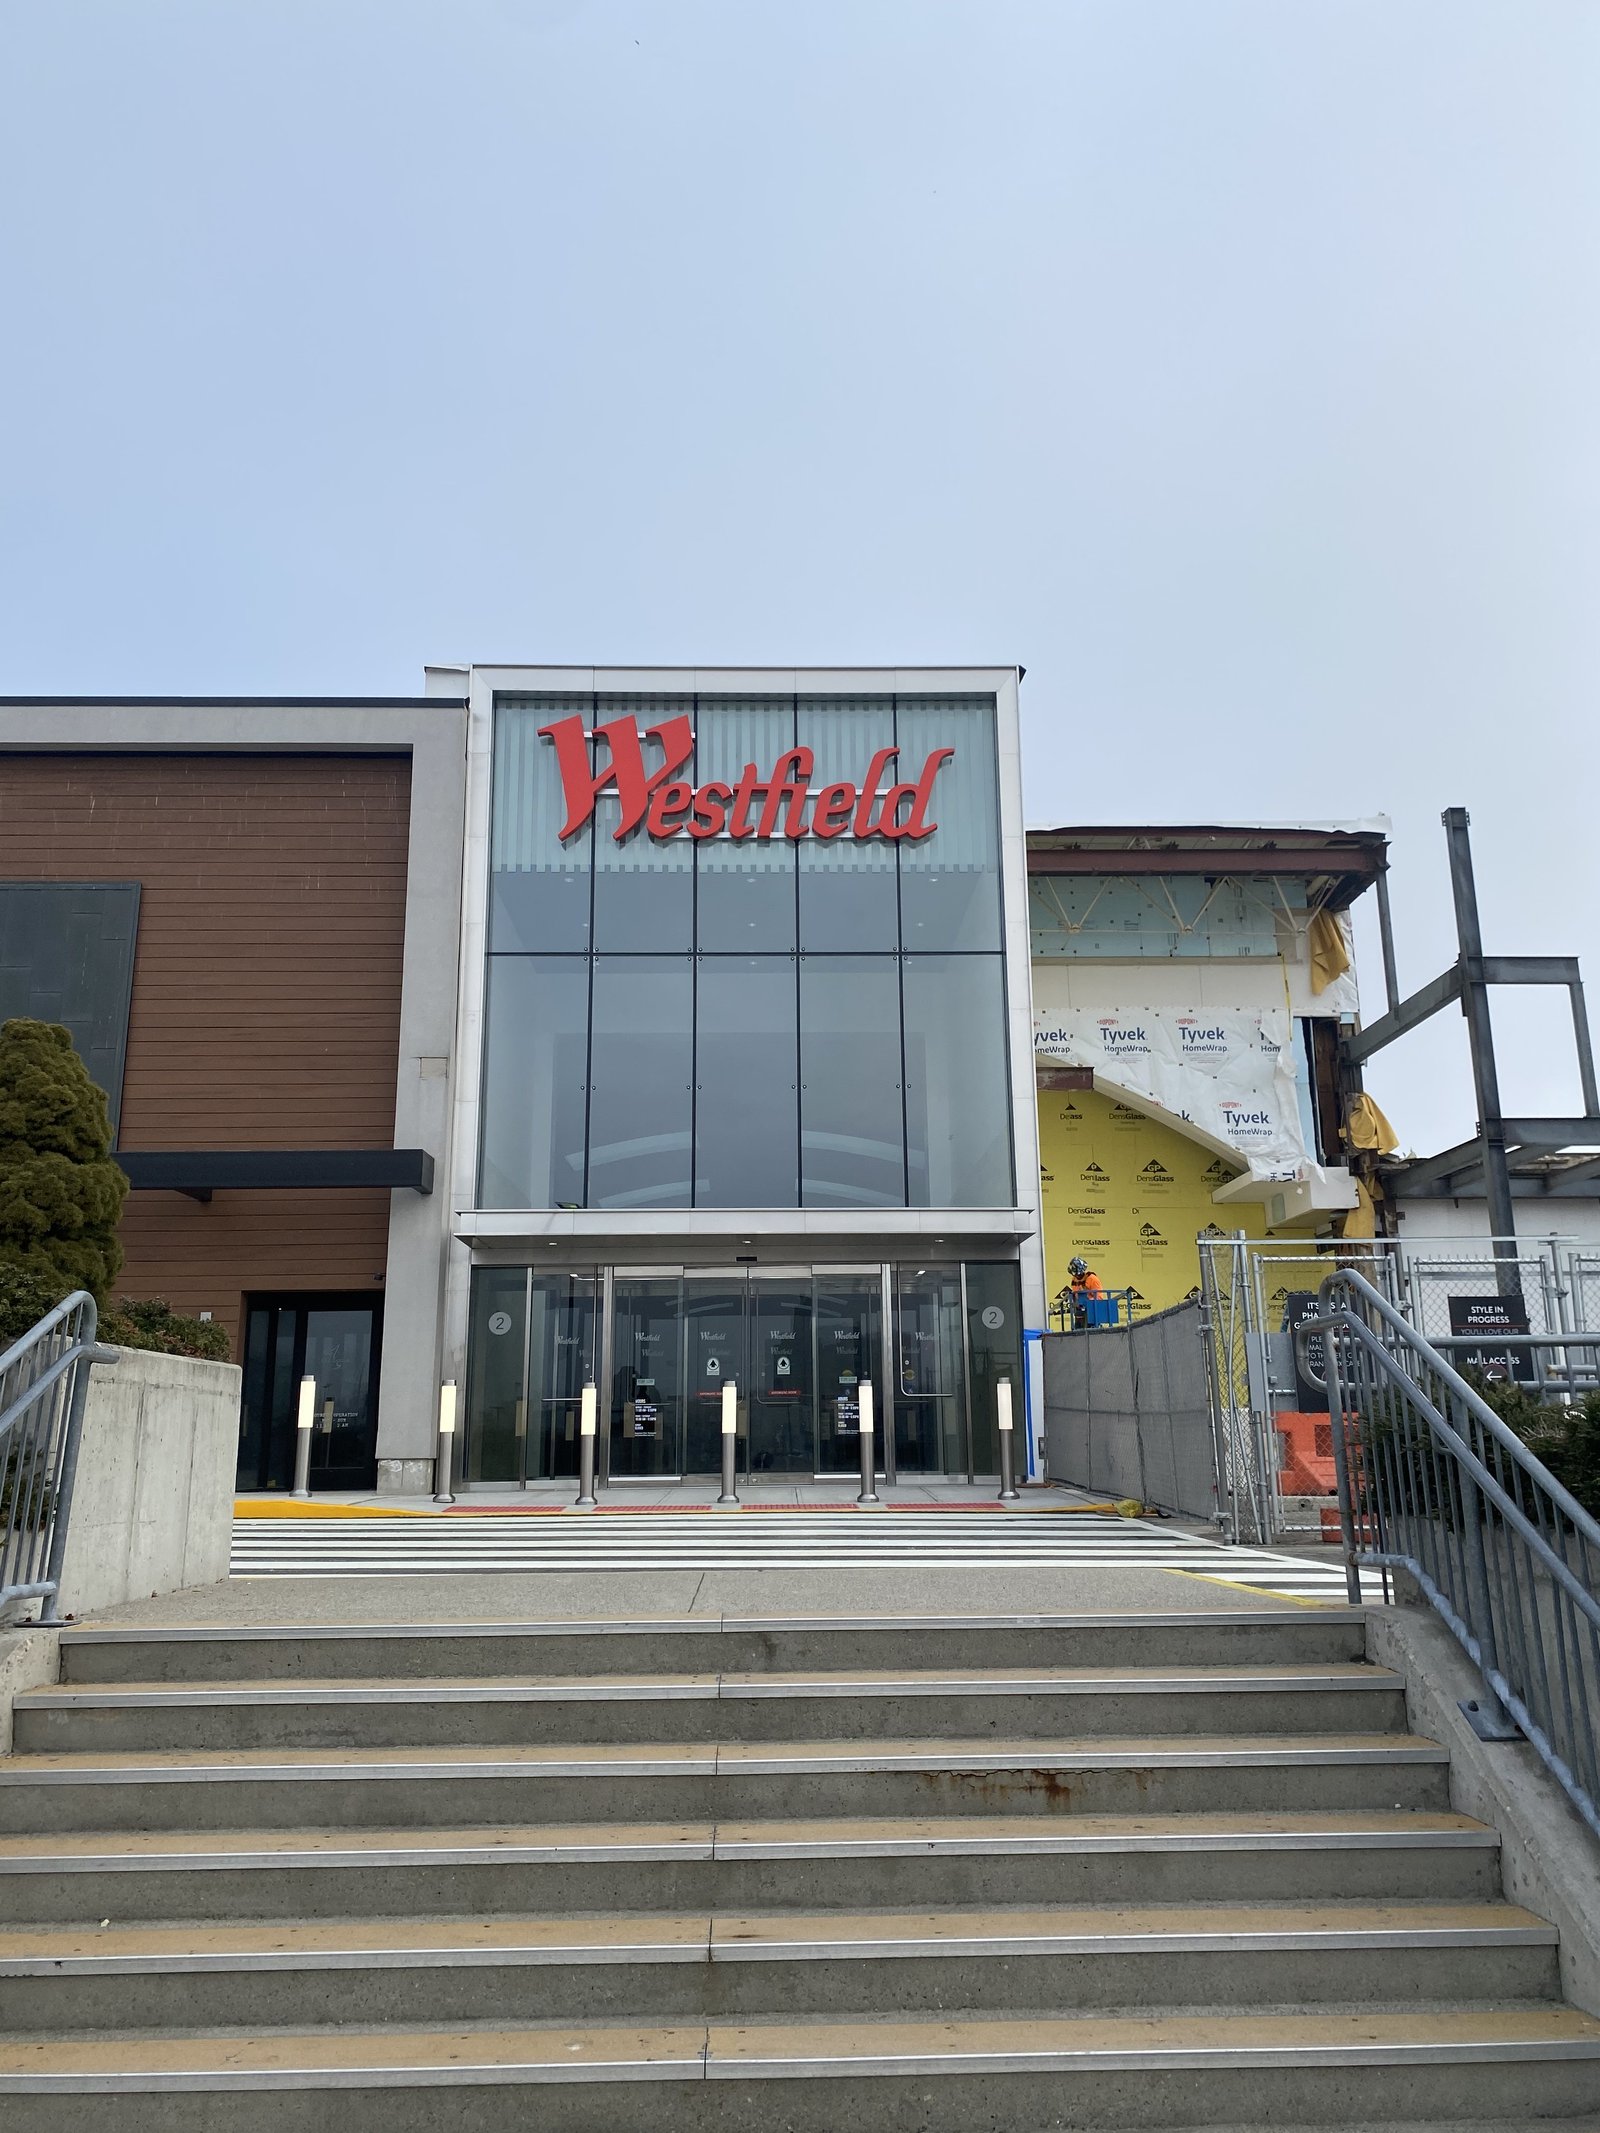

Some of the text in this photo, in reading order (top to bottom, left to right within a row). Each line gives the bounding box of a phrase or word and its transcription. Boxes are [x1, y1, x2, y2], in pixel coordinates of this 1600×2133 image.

[537, 714, 955, 841] Westfield
[1100, 1027, 1146, 1044] Tyvek
[1178, 1027, 1225, 1043] Tyvek
[1104, 1045, 1148, 1053] HomeWrap
[1182, 1044, 1228, 1053] HomeWrap
[1223, 1110, 1270, 1127] Tyvek
[1227, 1128, 1273, 1136] HomeWrap
[1067, 1207, 1106, 1215] DensGlass
[1471, 1306, 1494, 1314] STYLE
[989, 1311, 998, 1324] 2
[495, 1317, 504, 1330] 2
[635, 1332, 661, 1341] Westfield
[700, 1331, 726, 1341] Westfield
[770, 1330, 796, 1340] Westfield
[834, 1330, 860, 1340] Westfield
[1489, 1357, 1520, 1365] ACCSS
